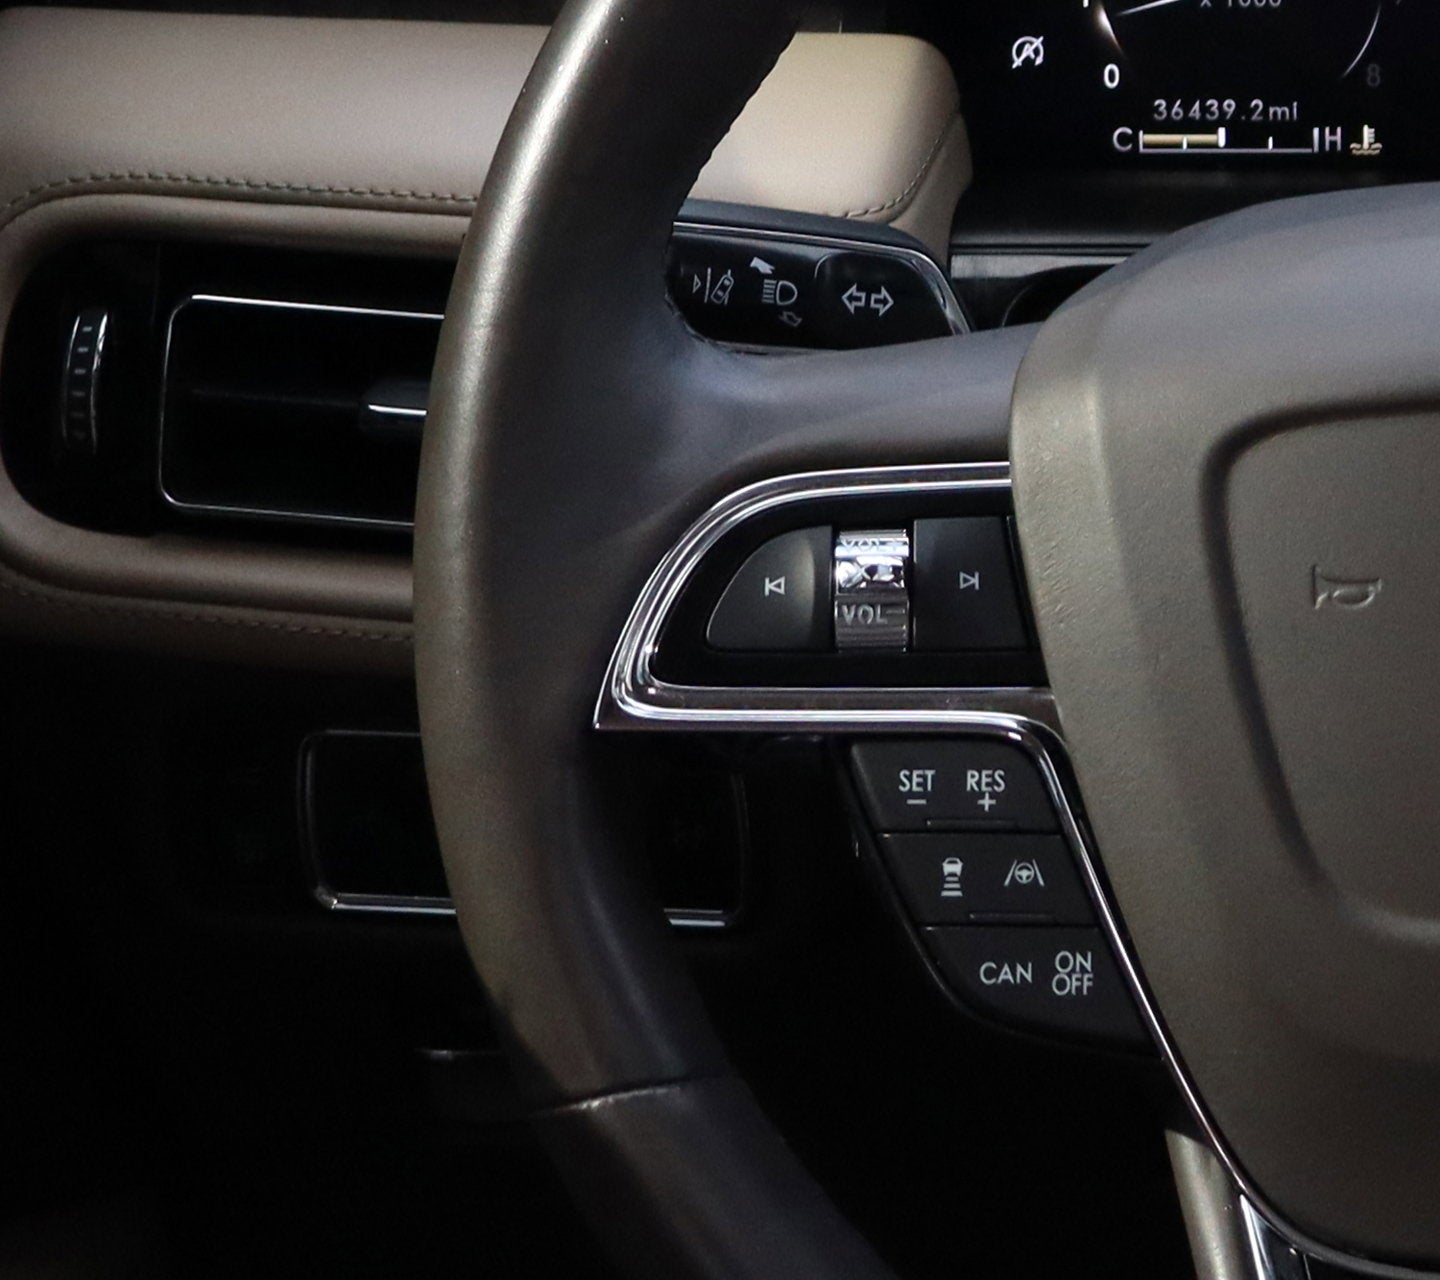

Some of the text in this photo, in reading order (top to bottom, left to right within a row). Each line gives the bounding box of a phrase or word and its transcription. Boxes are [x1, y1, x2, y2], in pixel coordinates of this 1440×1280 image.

[1102, 63, 1121, 89] 0
[1112, 127, 1133, 152] C
[1324, 127, 1342, 152] H
[897, 768, 1006, 795] SET RES
[979, 959, 1034, 986] CAN
[1053, 950, 1094, 975] ON
[1051, 973, 1095, 997] OFF
